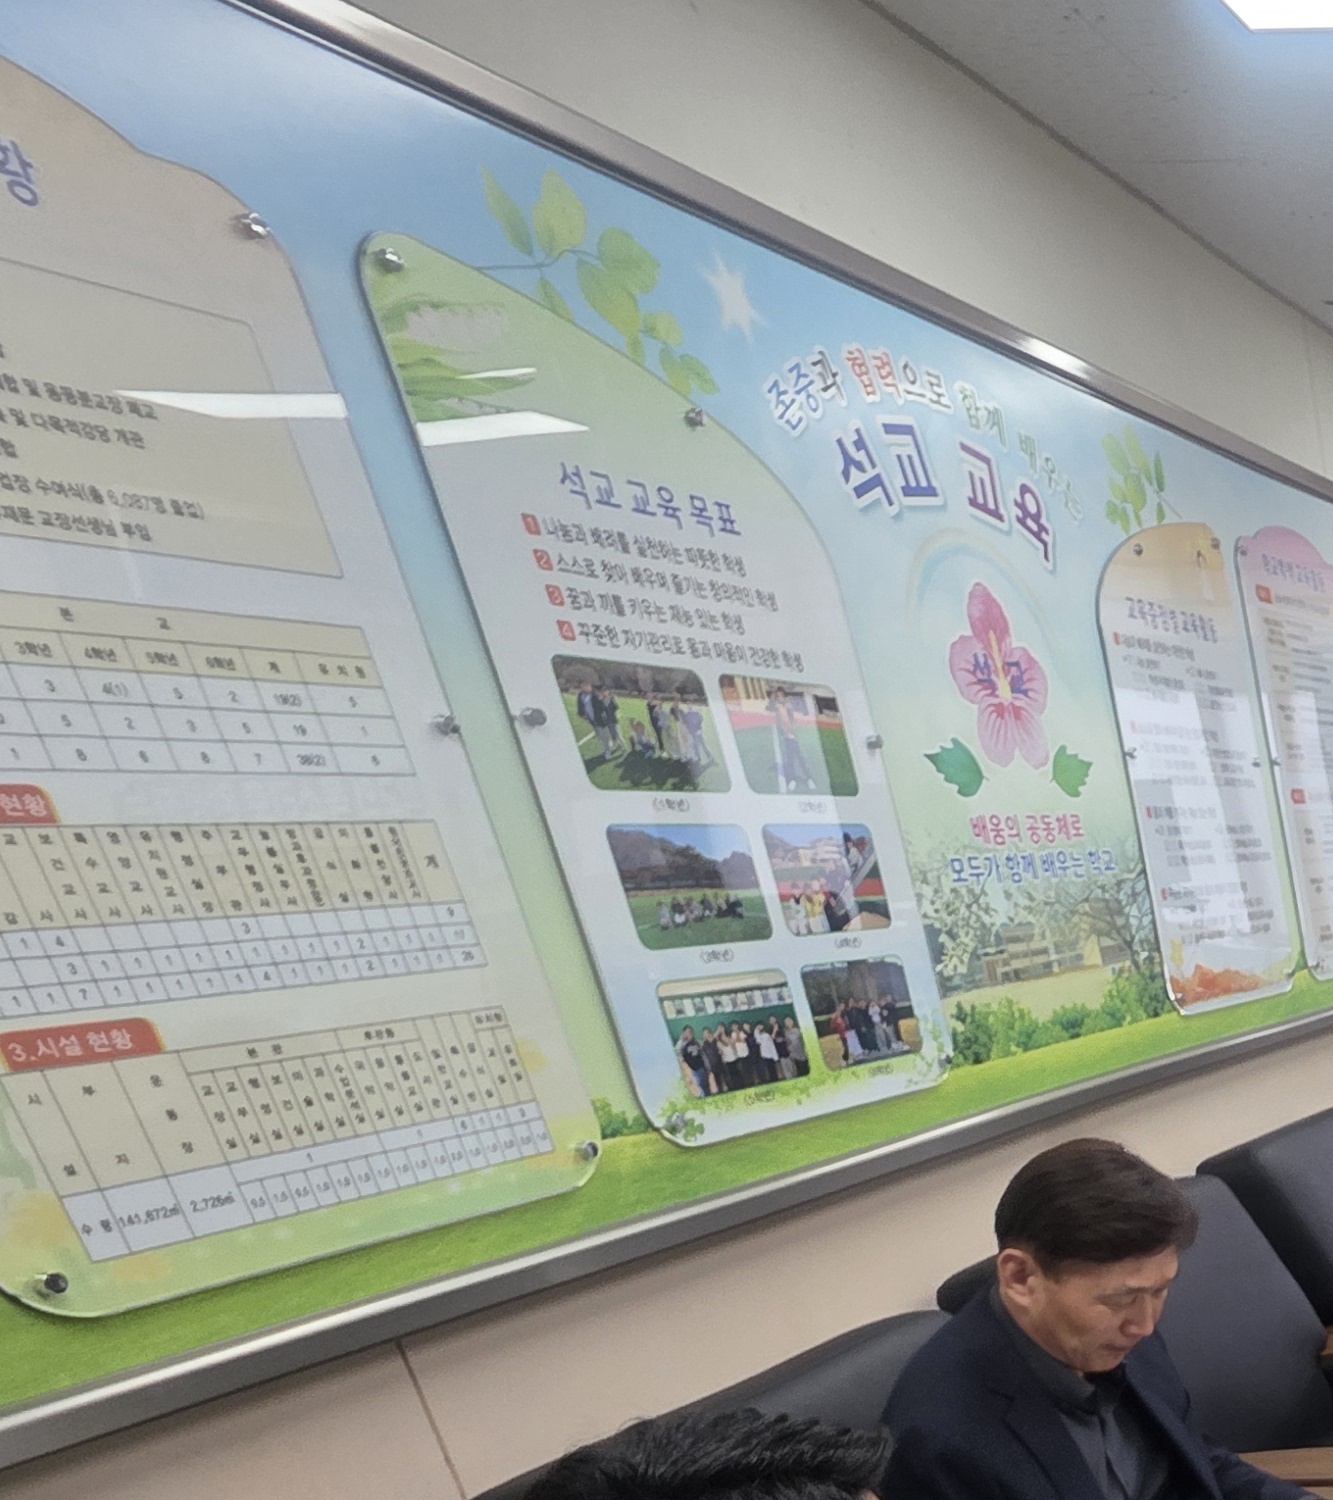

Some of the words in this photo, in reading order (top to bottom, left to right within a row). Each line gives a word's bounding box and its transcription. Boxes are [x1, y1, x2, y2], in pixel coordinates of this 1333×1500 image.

[767, 350, 845, 431] 존중과
[845, 347, 951, 410] 협력으로
[958, 385, 1007, 445] 함께
[560, 462, 621, 510] 석교
[626, 479, 683, 530] 교육
[689, 494, 742, 538] 목표
[836, 423, 938, 507] 석교
[959, 441, 1051, 563] 교육
[542, 516, 589, 546] 나눔과
[721, 553, 747, 578] 학생
[557, 553, 599, 579] 스스로
[578, 622, 621, 649] 꾸준한
[969, 814, 1022, 846] 배움의
[1025, 813, 1085, 844] 공동체로
[950, 855, 1003, 884] 모두가
[1005, 852, 1039, 883] 함께
[1040, 850, 1085, 879] 배우는
[1087, 849, 1116, 875] 학교
[8, 1037, 83, 1063] 3.시설
[86, 1028, 133, 1053] 현황
